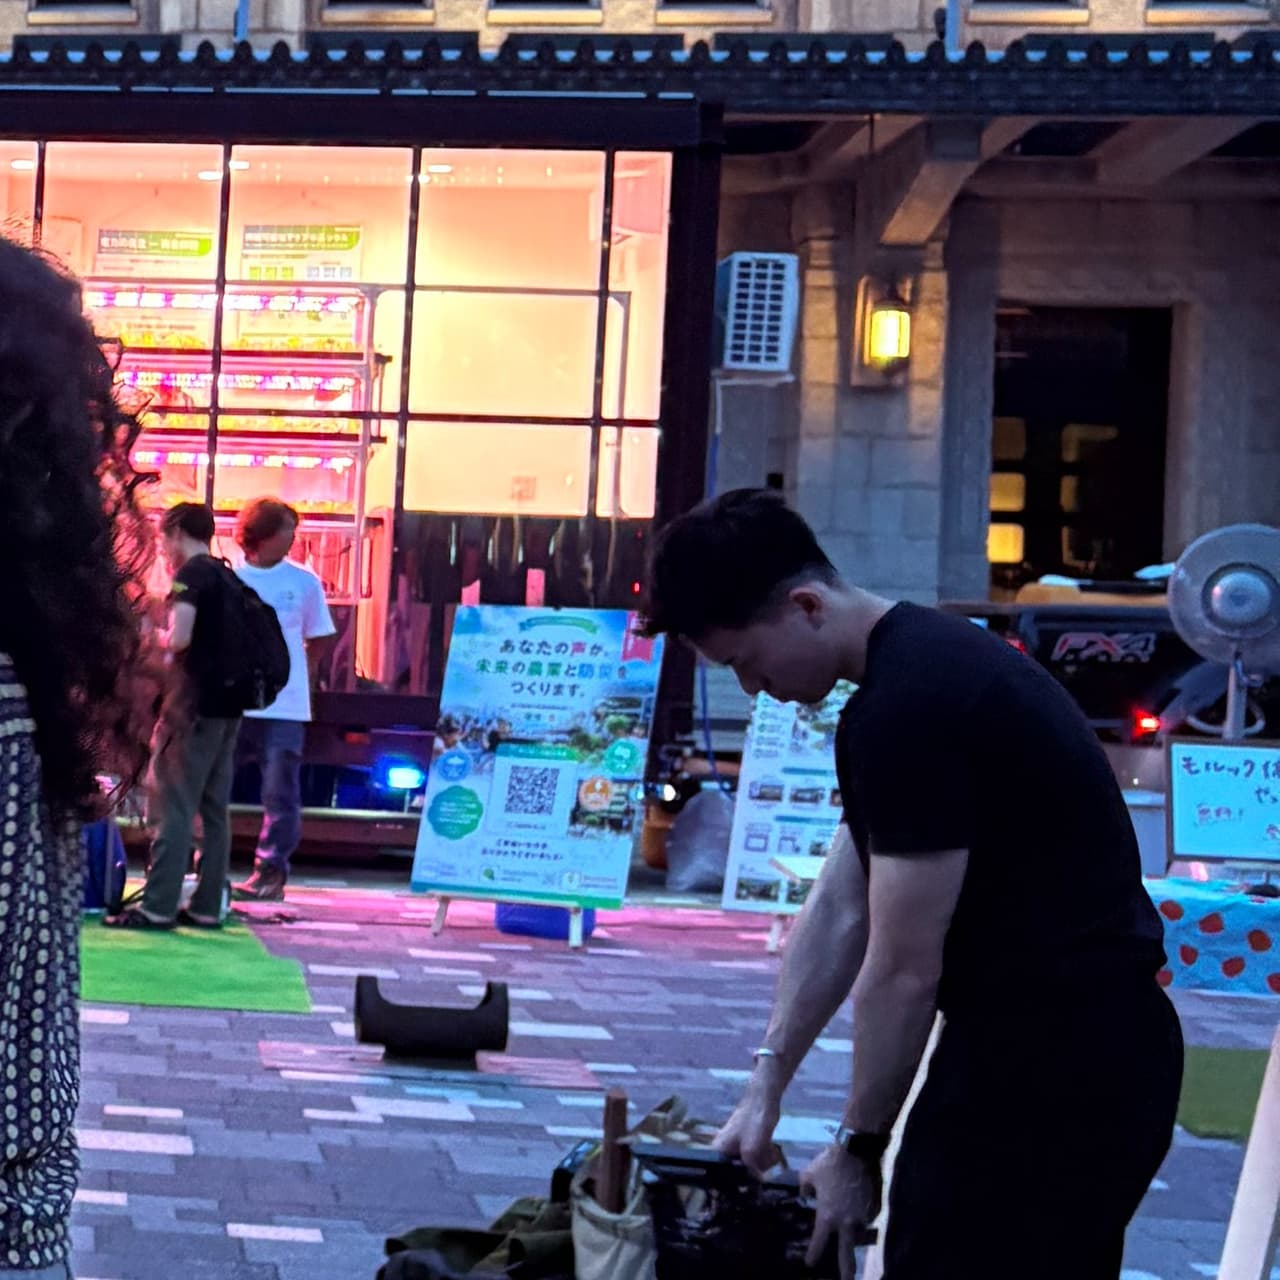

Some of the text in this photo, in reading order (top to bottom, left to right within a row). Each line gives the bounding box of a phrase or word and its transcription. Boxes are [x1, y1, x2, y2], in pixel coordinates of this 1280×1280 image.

[511, 681, 585, 698] つくります。
